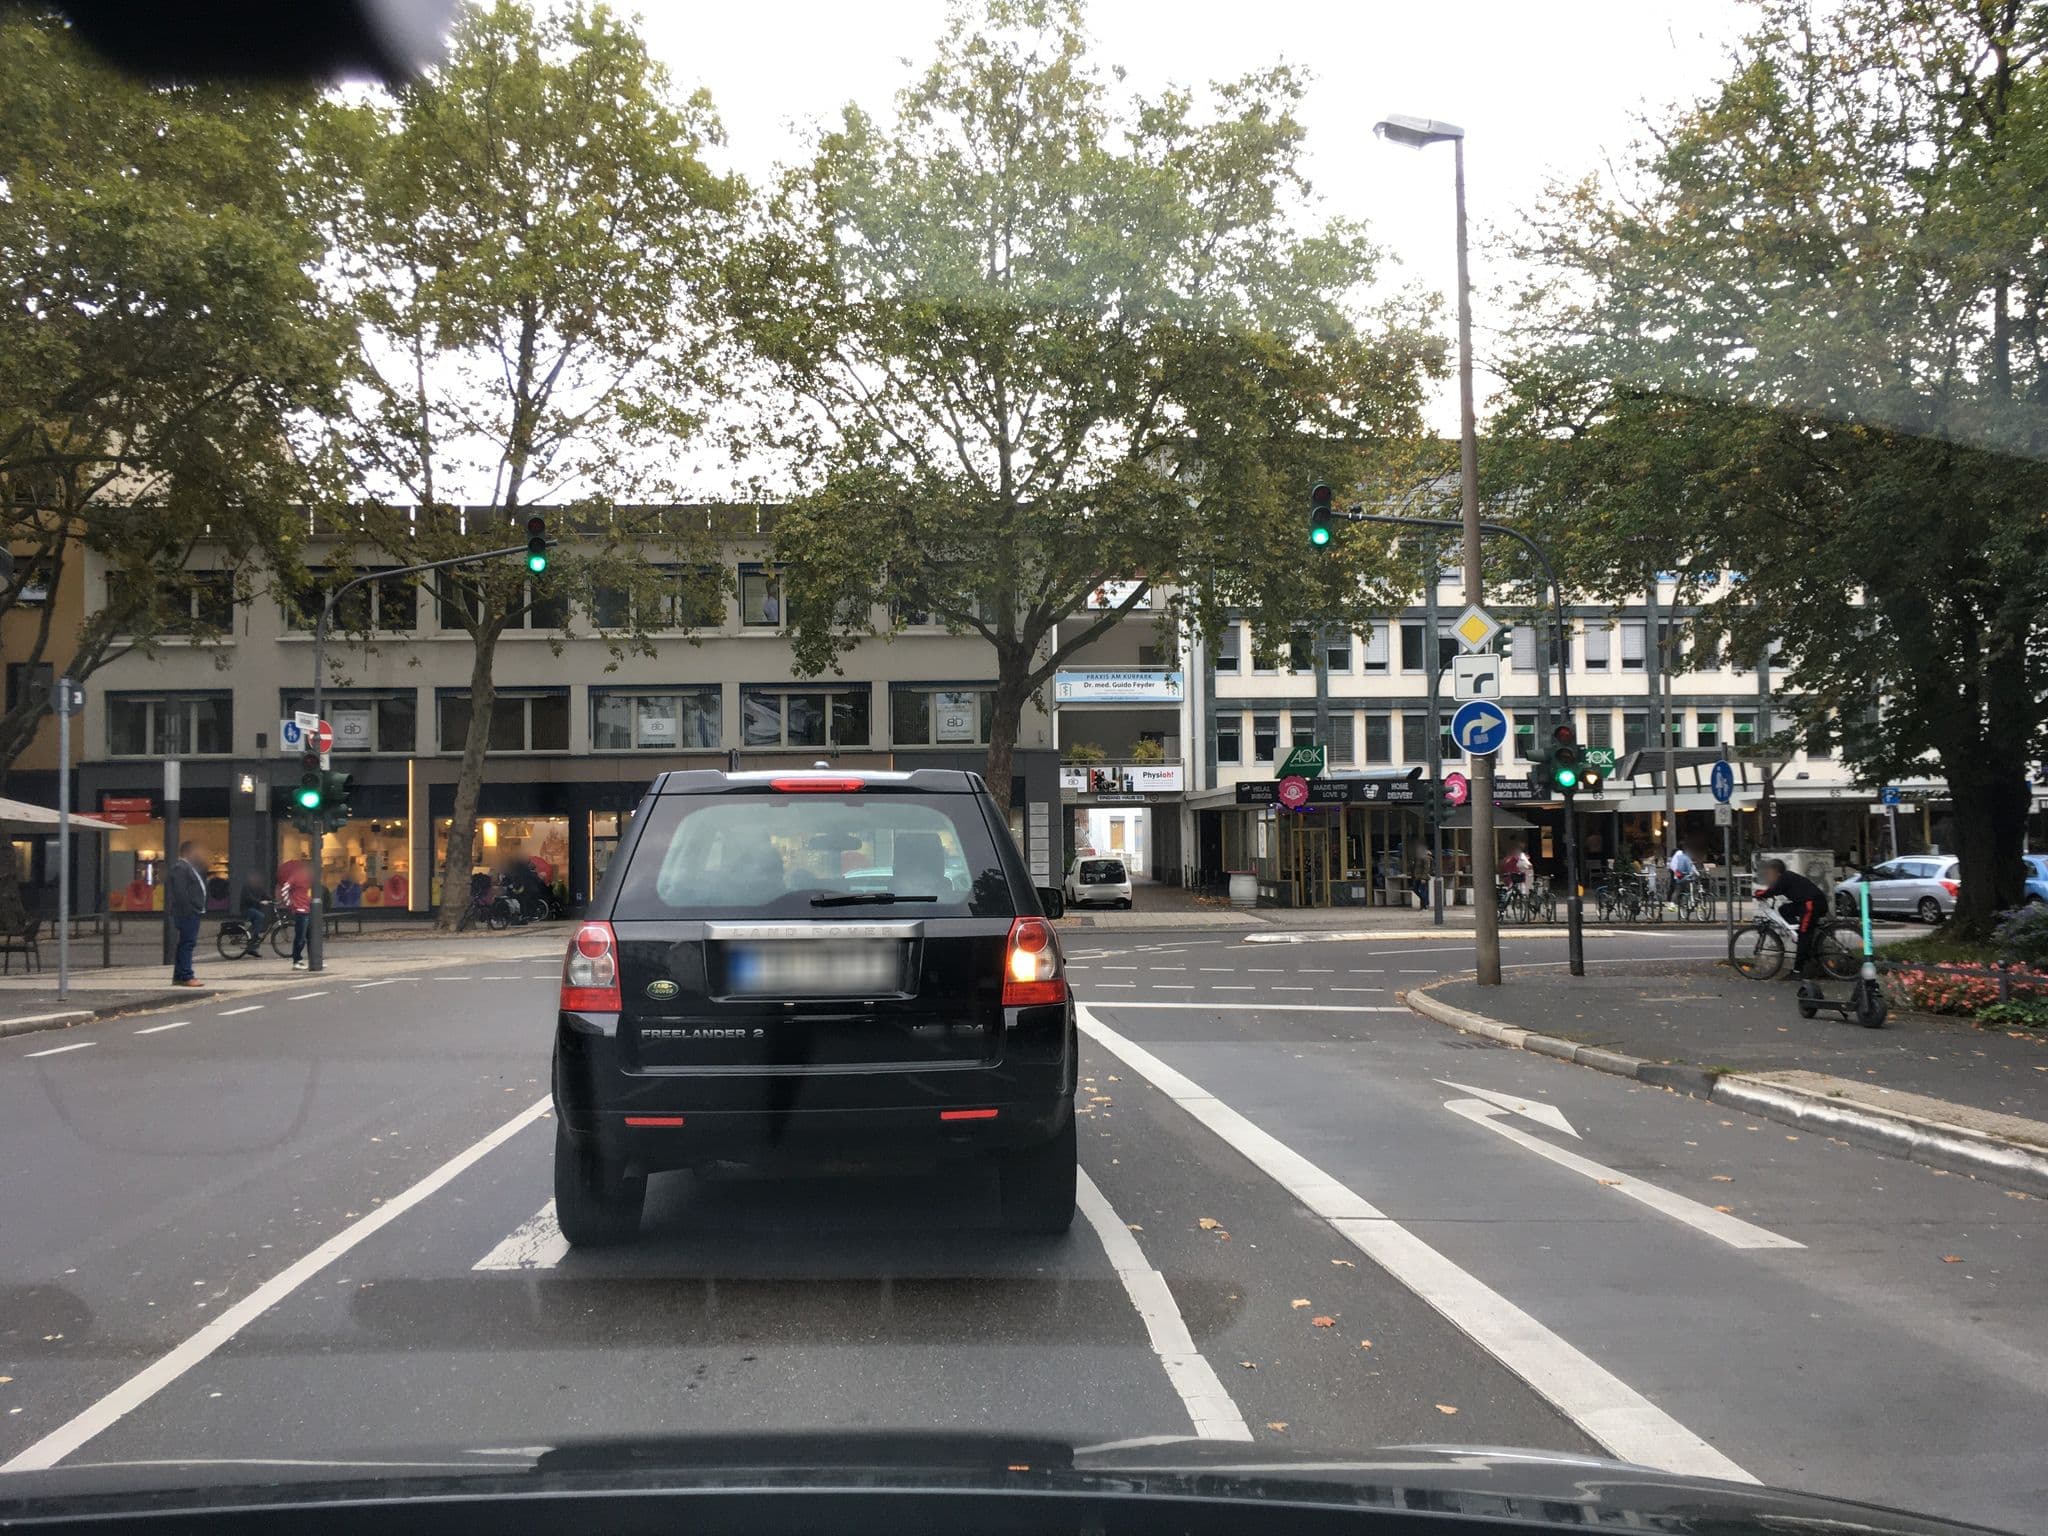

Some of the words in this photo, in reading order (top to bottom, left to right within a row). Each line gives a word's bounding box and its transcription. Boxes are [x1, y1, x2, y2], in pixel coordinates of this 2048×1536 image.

[1133, 681, 1155, 689] Feyder
[1290, 749, 1321, 763] AOK
[1142, 771, 1174, 780] Physioh!
[1391, 782, 1409, 790] HOME
[1387, 791, 1413, 799] DELIVERY
[733, 927, 797, 937] LAND
[812, 926, 897, 937] ROVER
[641, 1029, 747, 1039] FREELANDER
[753, 1029, 765, 1038] 2
